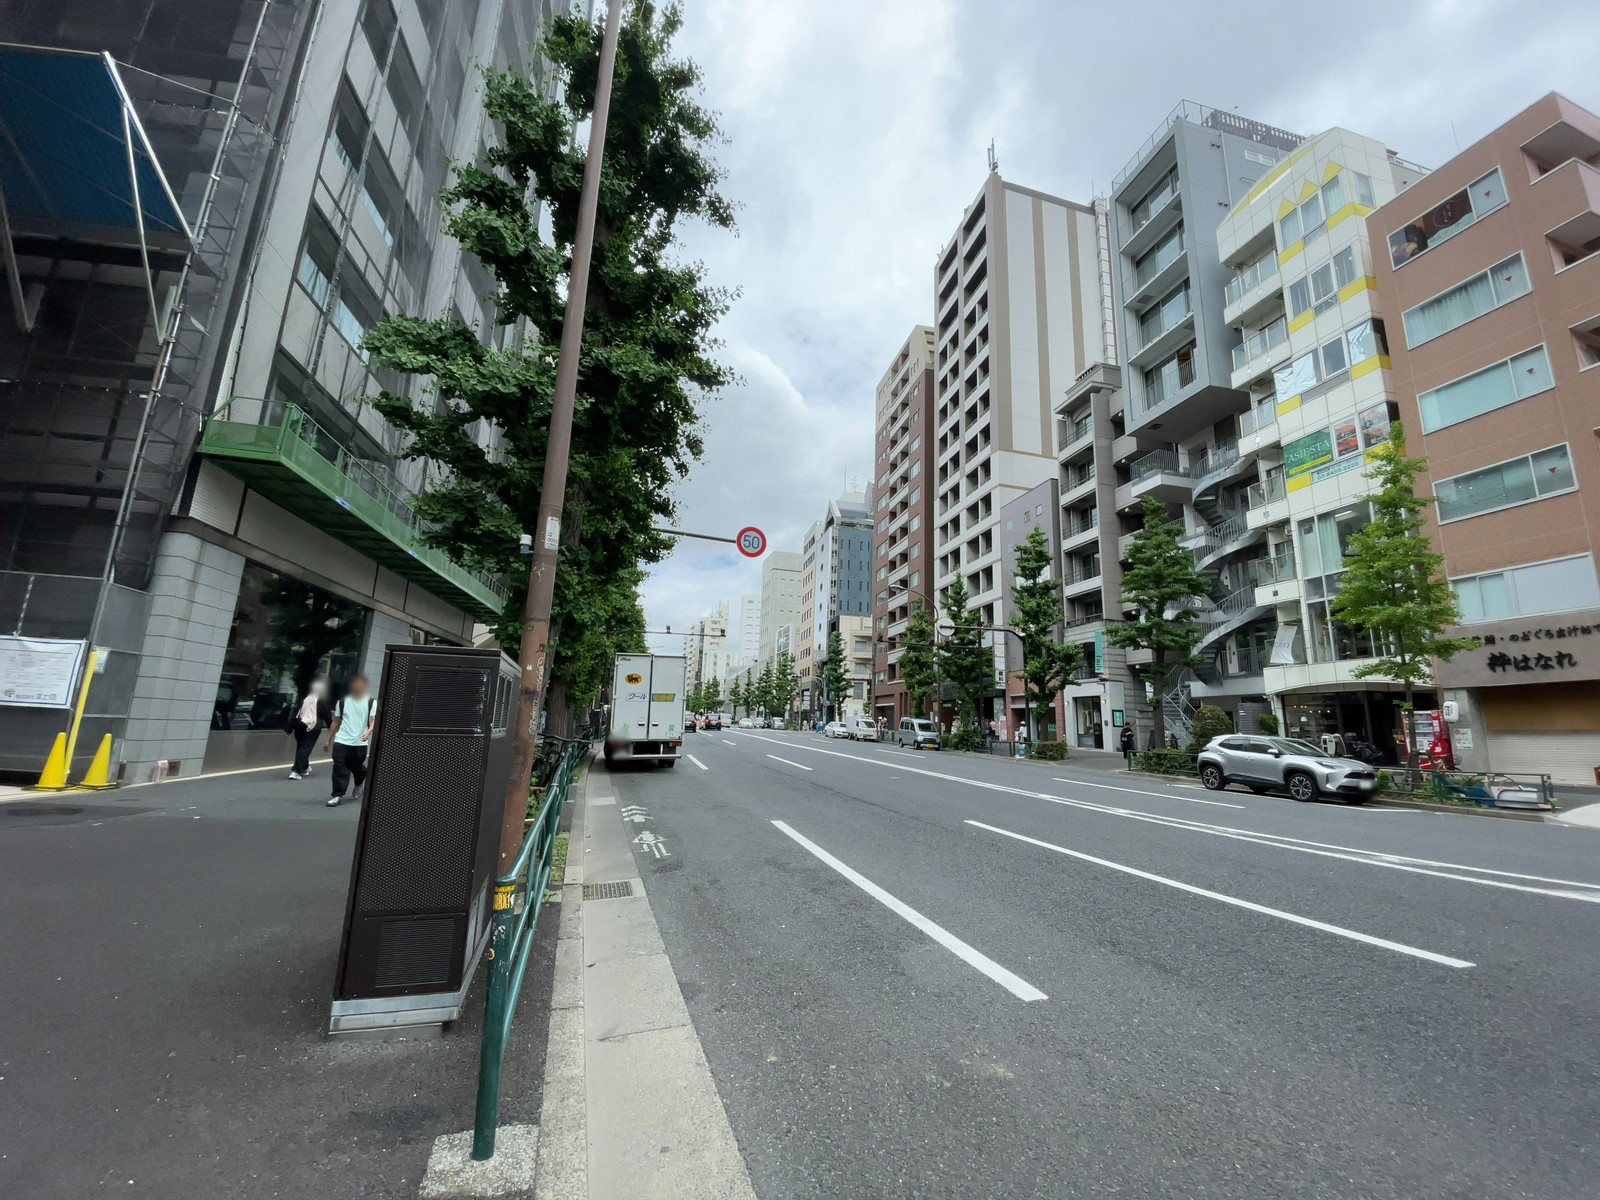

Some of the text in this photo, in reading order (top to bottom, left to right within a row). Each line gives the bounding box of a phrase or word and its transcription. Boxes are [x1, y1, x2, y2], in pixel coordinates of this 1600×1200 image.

[1288, 440, 1330, 463] ASIESTA
[743, 534, 760, 550] 50
[1486, 650, 1578, 673] 粋はなれ
